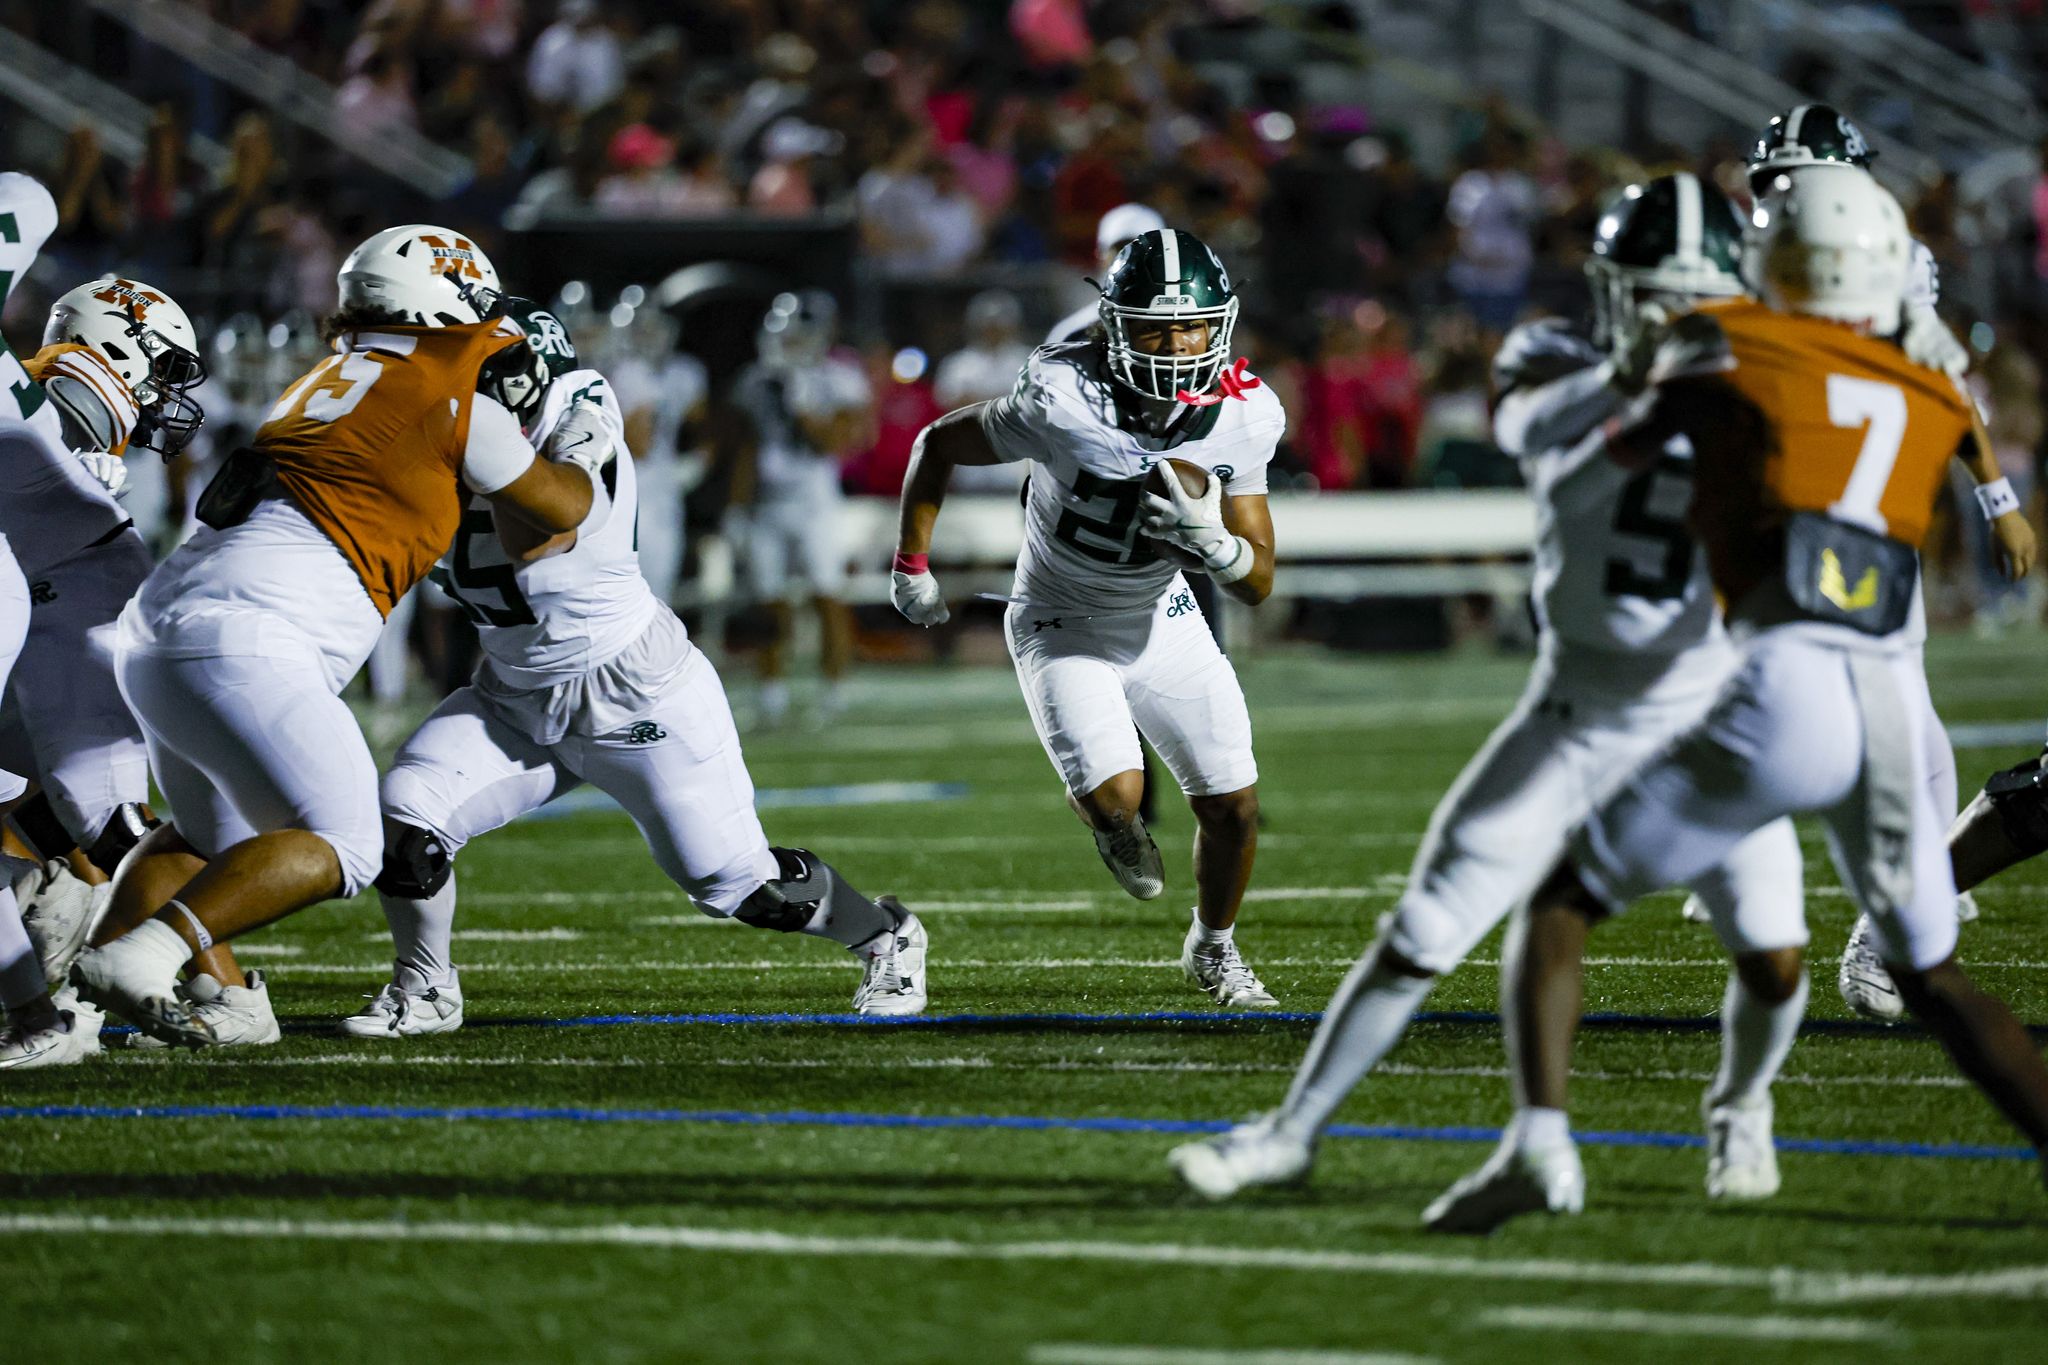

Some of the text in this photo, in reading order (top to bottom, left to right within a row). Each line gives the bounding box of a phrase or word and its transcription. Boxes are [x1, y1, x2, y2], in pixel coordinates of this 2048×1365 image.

[110, 284, 153, 308] MADISON
[1156, 296, 1178, 306] STRIKE
[1826, 373, 1908, 535] 7
